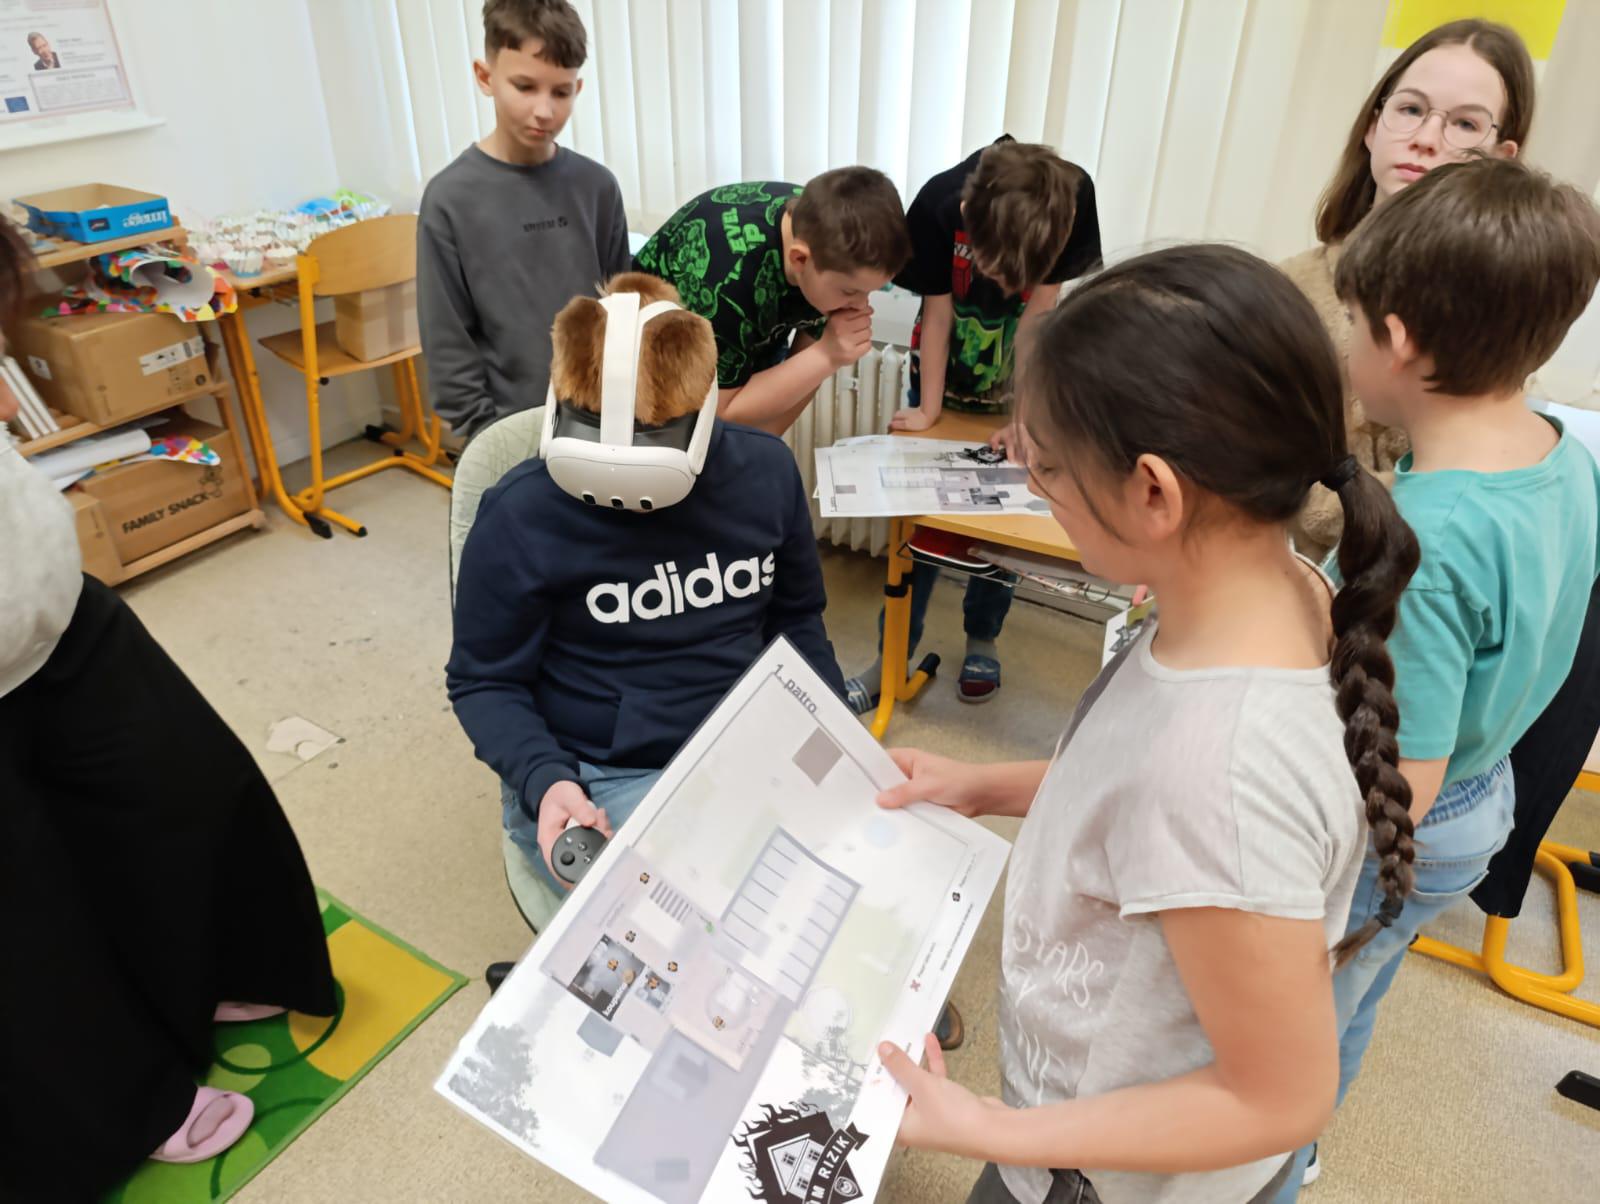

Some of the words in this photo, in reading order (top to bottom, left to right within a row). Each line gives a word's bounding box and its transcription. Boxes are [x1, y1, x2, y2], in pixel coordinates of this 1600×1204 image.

[121, 508, 166, 535] FAMILY
[168, 491, 210, 516] SNACK
[586, 551, 776, 624] adidas
[784, 679, 818, 714] patro
[818, 1135, 850, 1179] RIZIK
